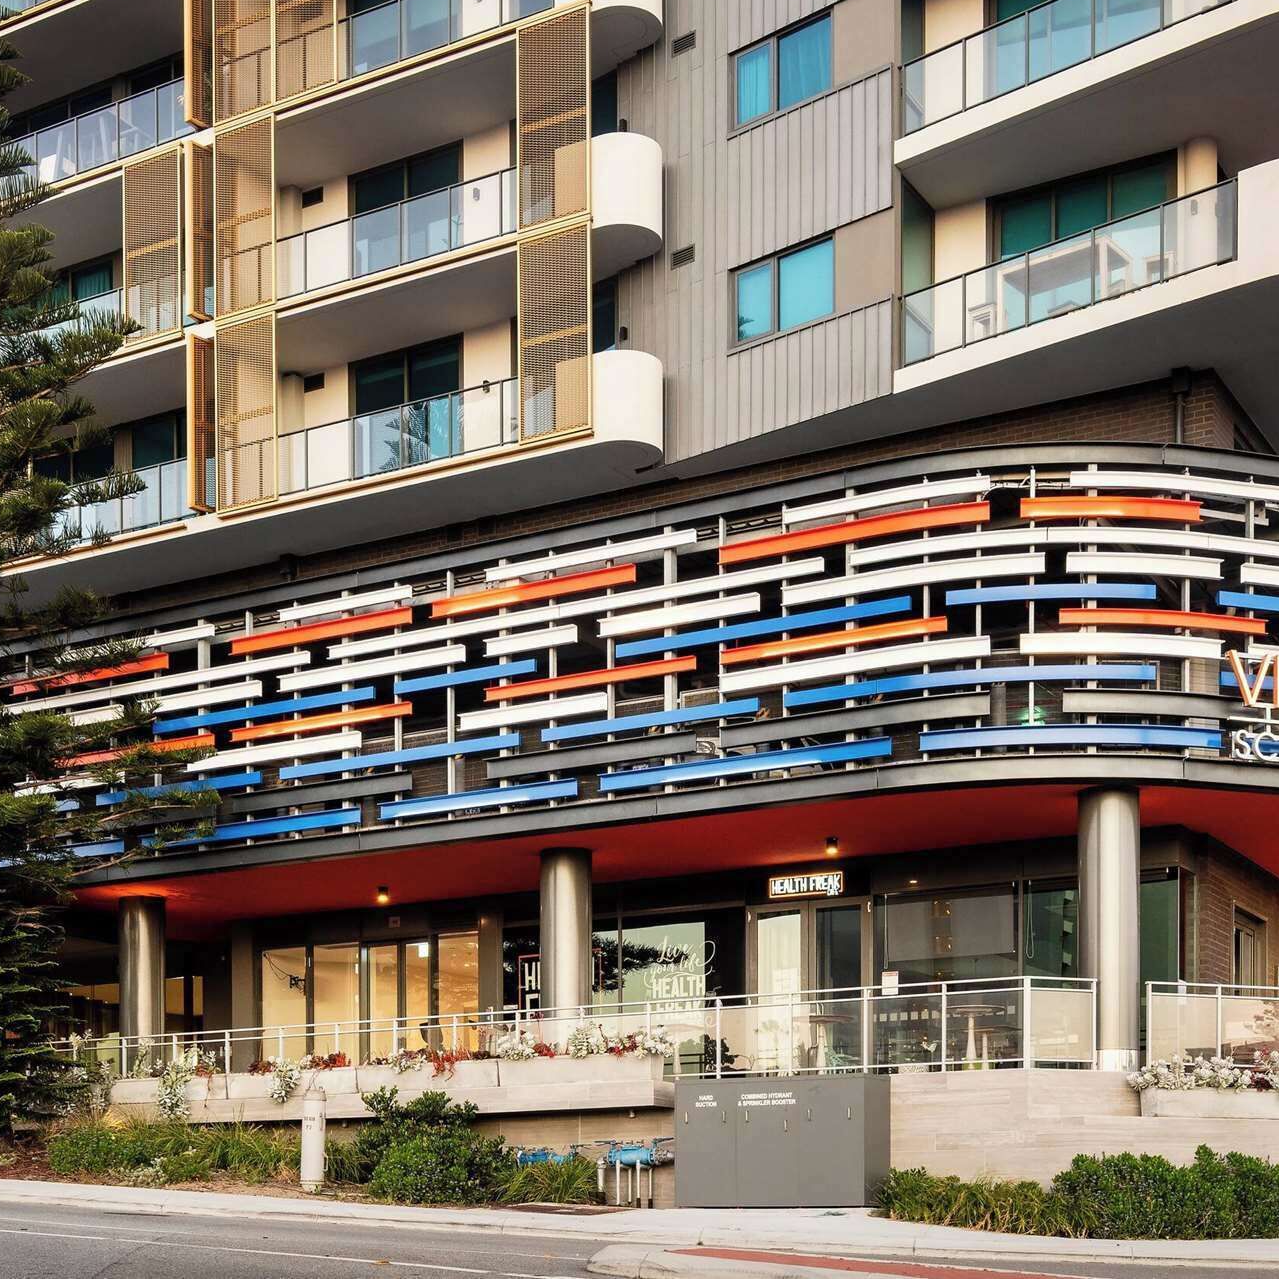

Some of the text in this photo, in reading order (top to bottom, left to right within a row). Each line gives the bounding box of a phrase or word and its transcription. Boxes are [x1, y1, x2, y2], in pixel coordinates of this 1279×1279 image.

[771, 874, 840, 895] HEALTH FREAK
[651, 975, 706, 999] HEALTH
